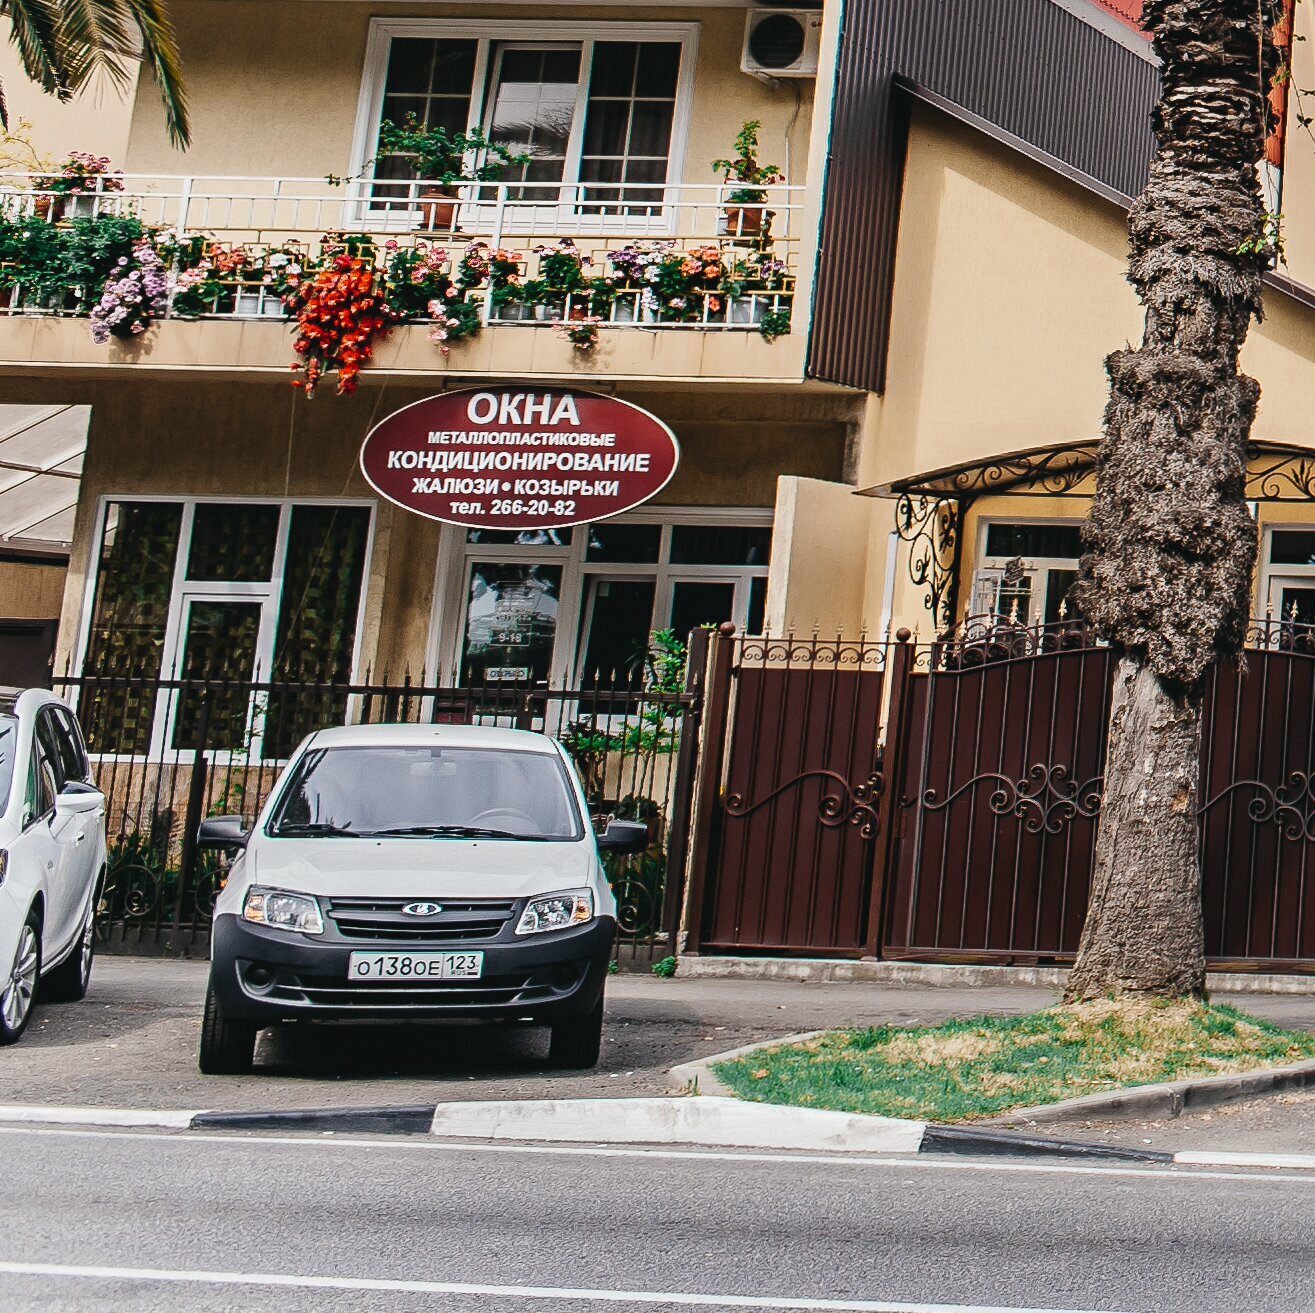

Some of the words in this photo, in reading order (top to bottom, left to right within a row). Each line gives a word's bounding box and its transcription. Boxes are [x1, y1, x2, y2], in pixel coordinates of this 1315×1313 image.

[467, 392, 580, 426] ОКНА
[427, 431, 616, 447] МЕТАЛЛОПЛАСТИКОВЫЕ
[387, 451, 651, 473] КОНДИЦИОНИРОВАНИЕ
[411, 477, 498, 495] ЖАЛЮЗИ
[514, 479, 619, 496] КОЗЫРЬКИ
[450, 501, 485, 515] тел.
[490, 500, 576, 516] 266-20-82
[446, 956, 477, 970] 123
